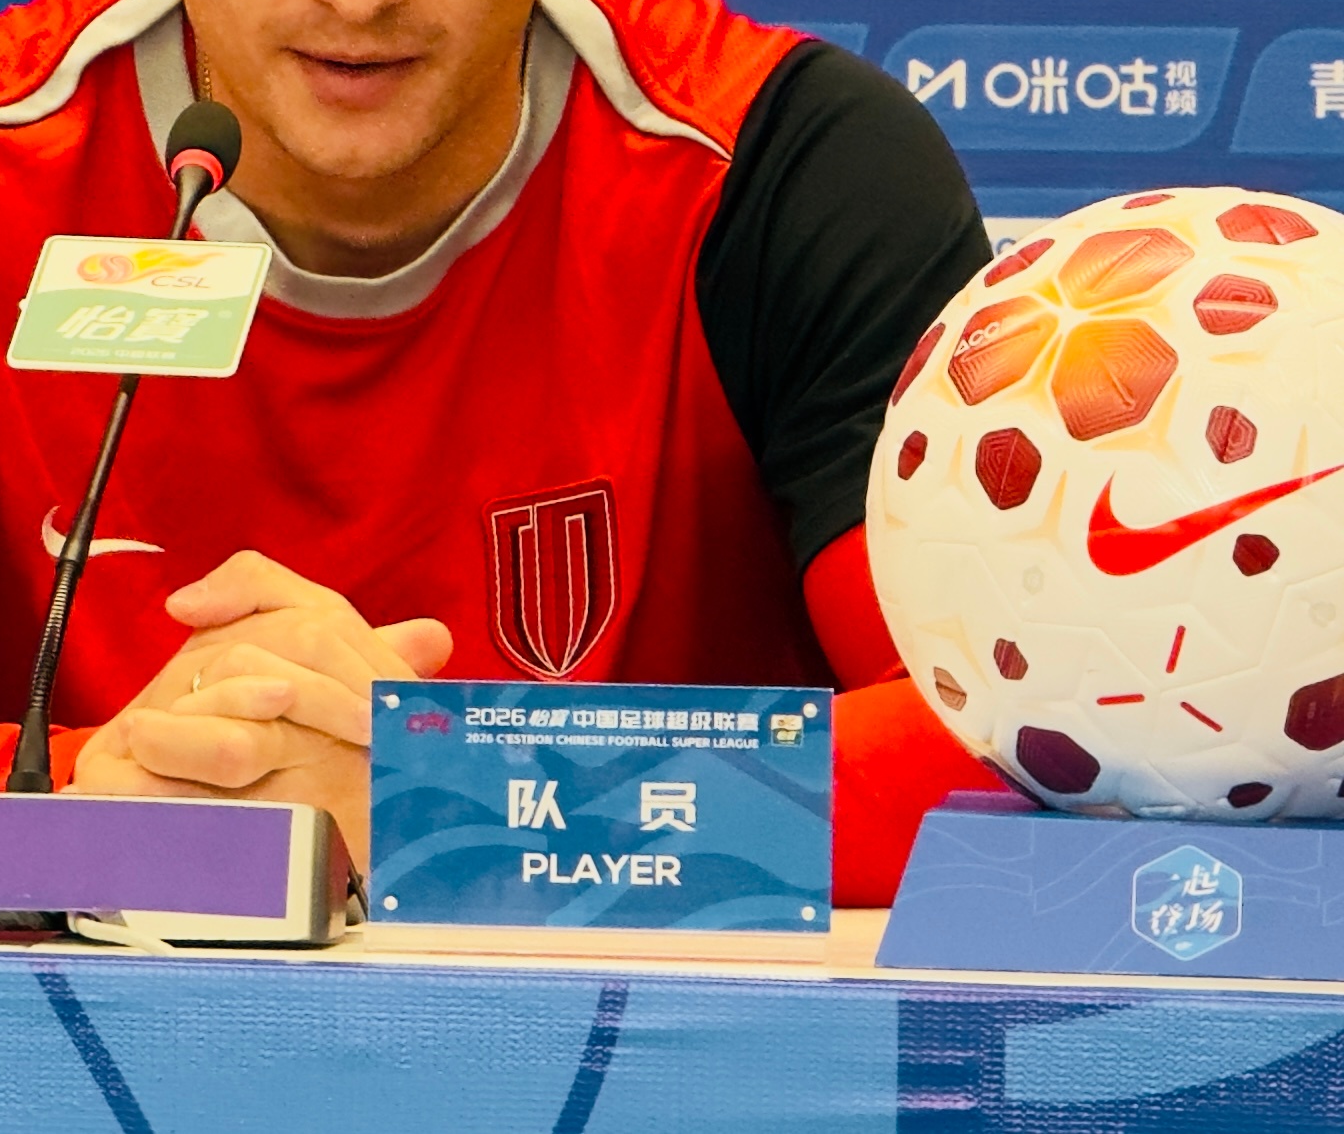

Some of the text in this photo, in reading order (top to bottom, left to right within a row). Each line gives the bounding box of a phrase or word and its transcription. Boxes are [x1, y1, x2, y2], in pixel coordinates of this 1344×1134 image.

[150, 274, 212, 290] CSL
[465, 707, 526, 727] 2026
[572, 710, 759, 732] 中国足球超级联赛
[465, 733, 494, 744] 2026
[555, 736, 605, 746] CHINESE
[607, 736, 669, 748] FOOTBALL
[671, 738, 711, 749] SUPER
[713, 738, 759, 750] LEAGUE
[522, 852, 681, 887] PLAYER
